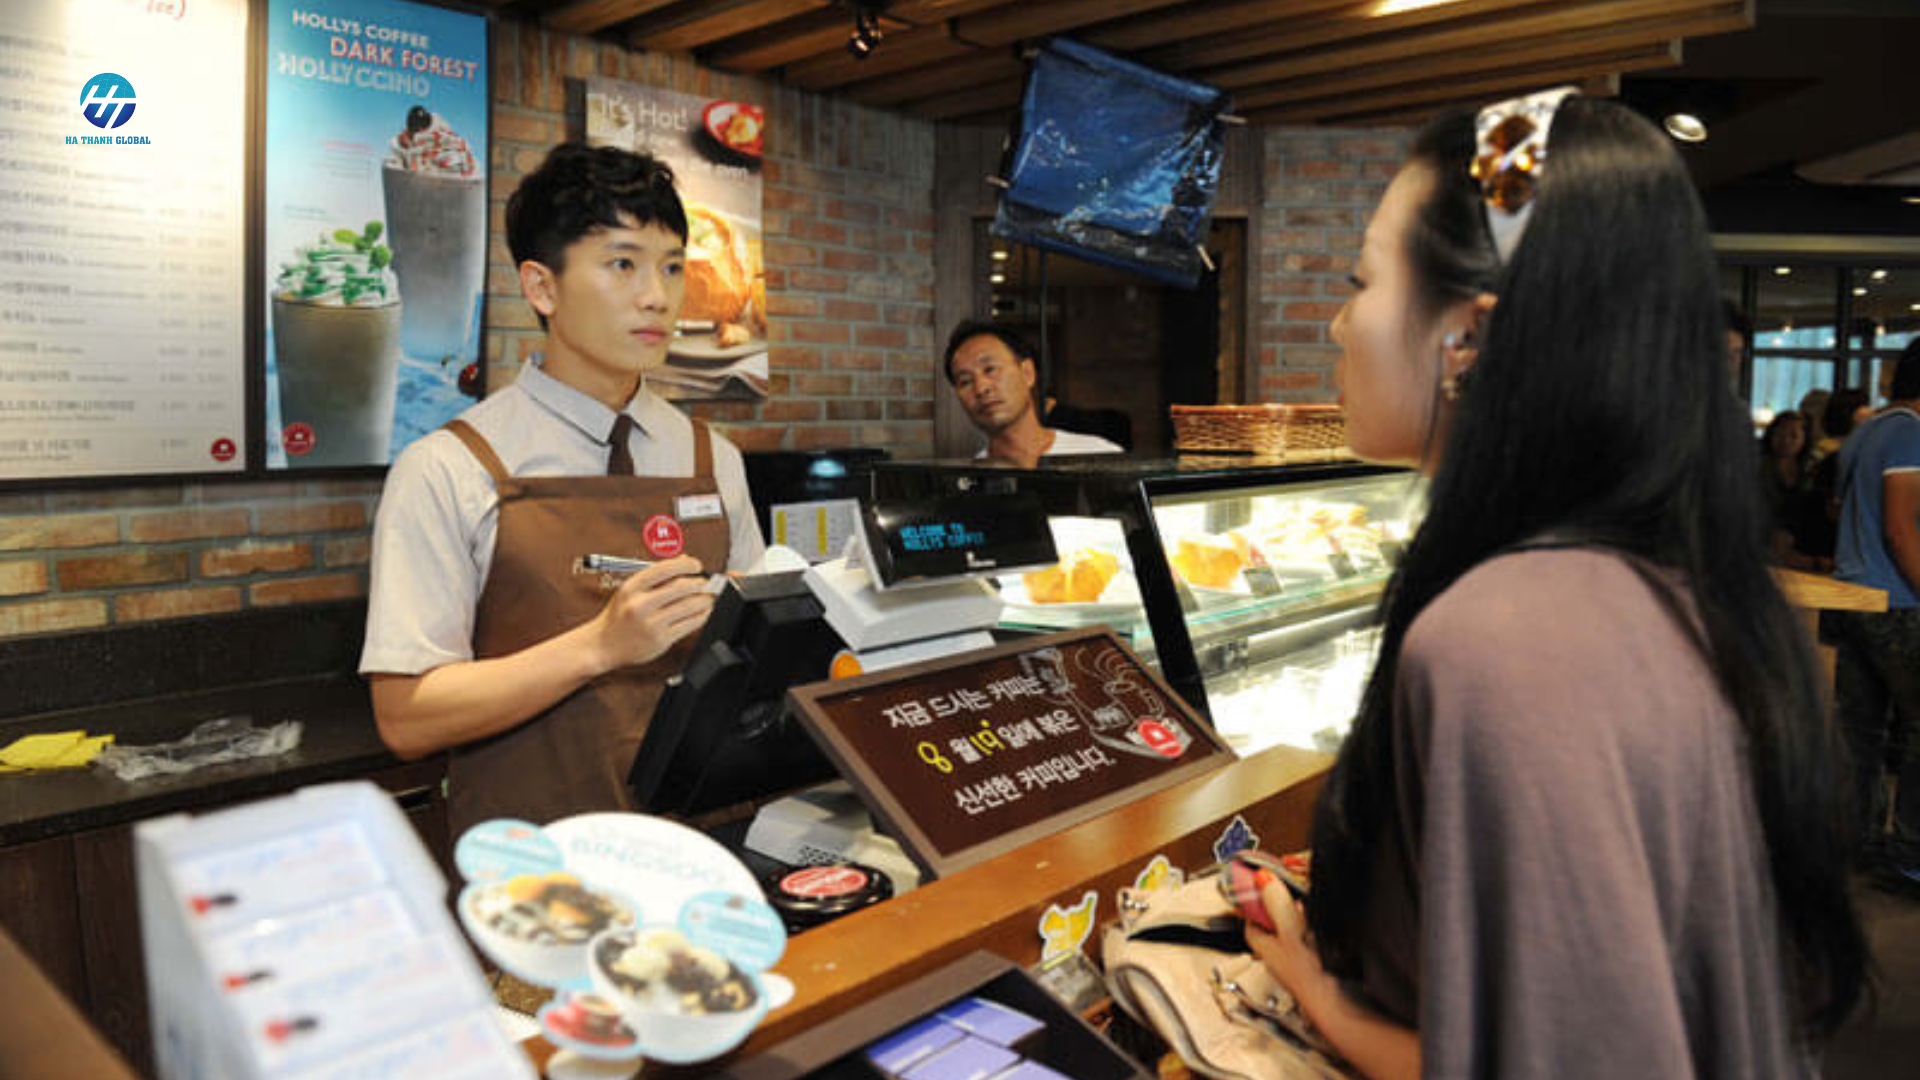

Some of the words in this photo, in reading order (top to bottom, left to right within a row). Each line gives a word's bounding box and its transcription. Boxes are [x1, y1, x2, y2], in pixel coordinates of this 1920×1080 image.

[292, 9, 361, 35] HOLLYS
[365, 25, 429, 48] COFFEE
[278, 52, 431, 97] HOLLYCCINO
[331, 36, 396, 67] DARK
[402, 50, 479, 81] FOREST
[901, 525, 946, 538] WELCOME
[882, 700, 934, 728] 지금
[928, 688, 993, 718] 드시는
[986, 675, 1045, 700] 커피는
[1035, 709, 1080, 735] 볶은
[954, 775, 1023, 815] 신선한
[1016, 745, 1117, 790] 커피입니다.
